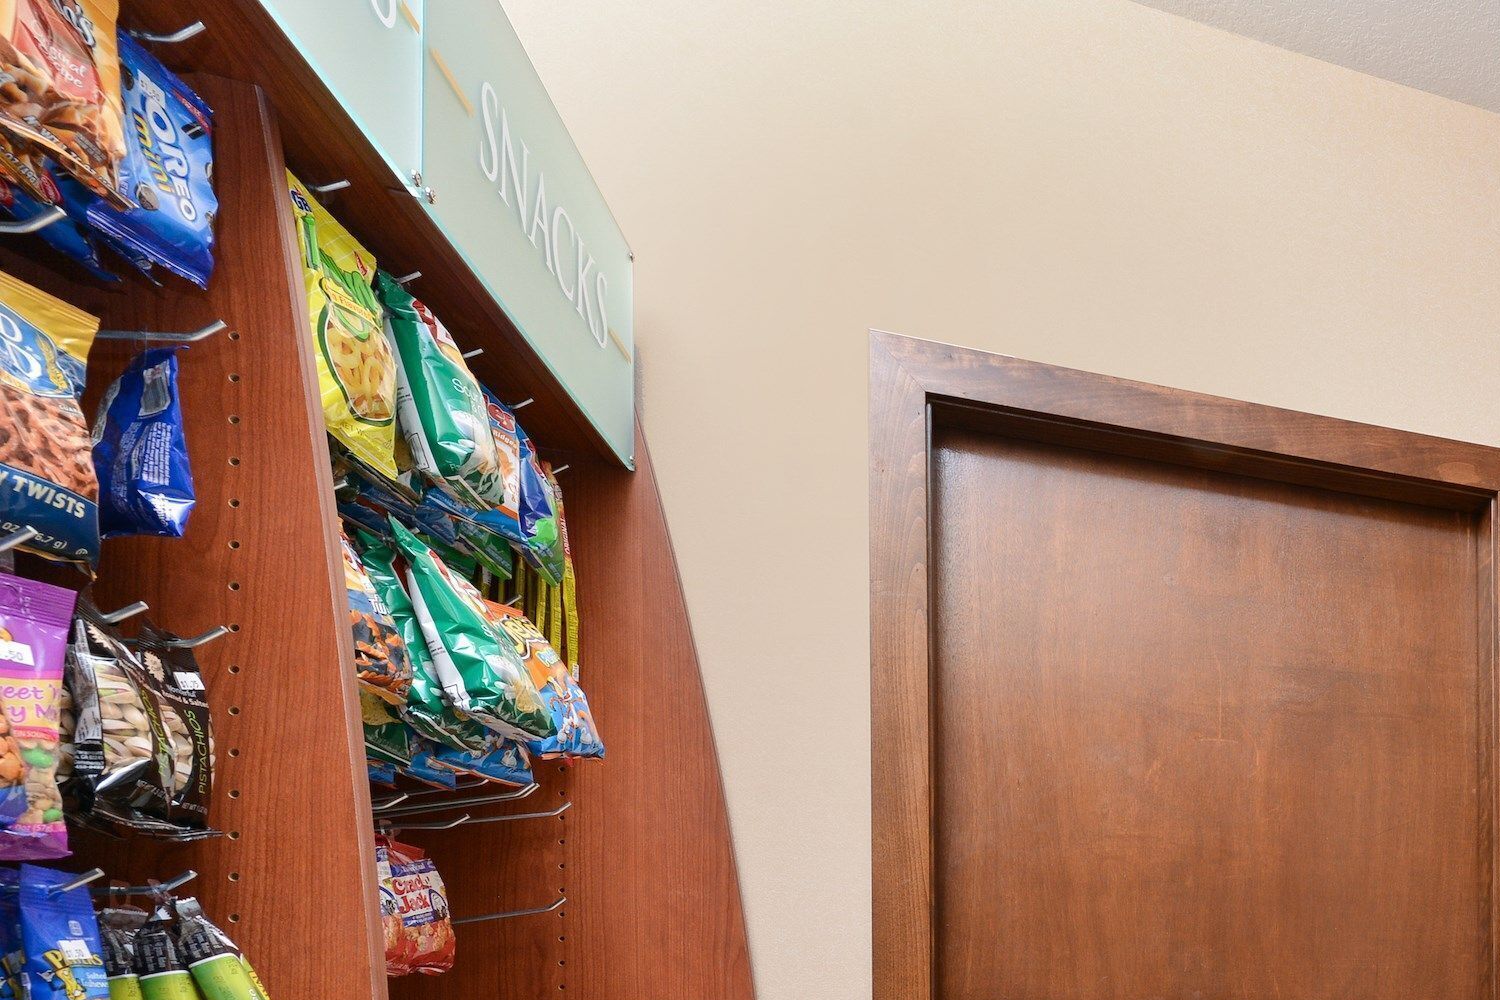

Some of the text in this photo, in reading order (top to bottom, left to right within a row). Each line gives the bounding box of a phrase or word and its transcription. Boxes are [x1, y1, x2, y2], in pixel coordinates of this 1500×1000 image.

[144, 97, 197, 222] OREO
[480, 81, 609, 348] SNACKS
[12, 474, 86, 519] TWISTS
[184, 709, 206, 795] PISTACHIOS
